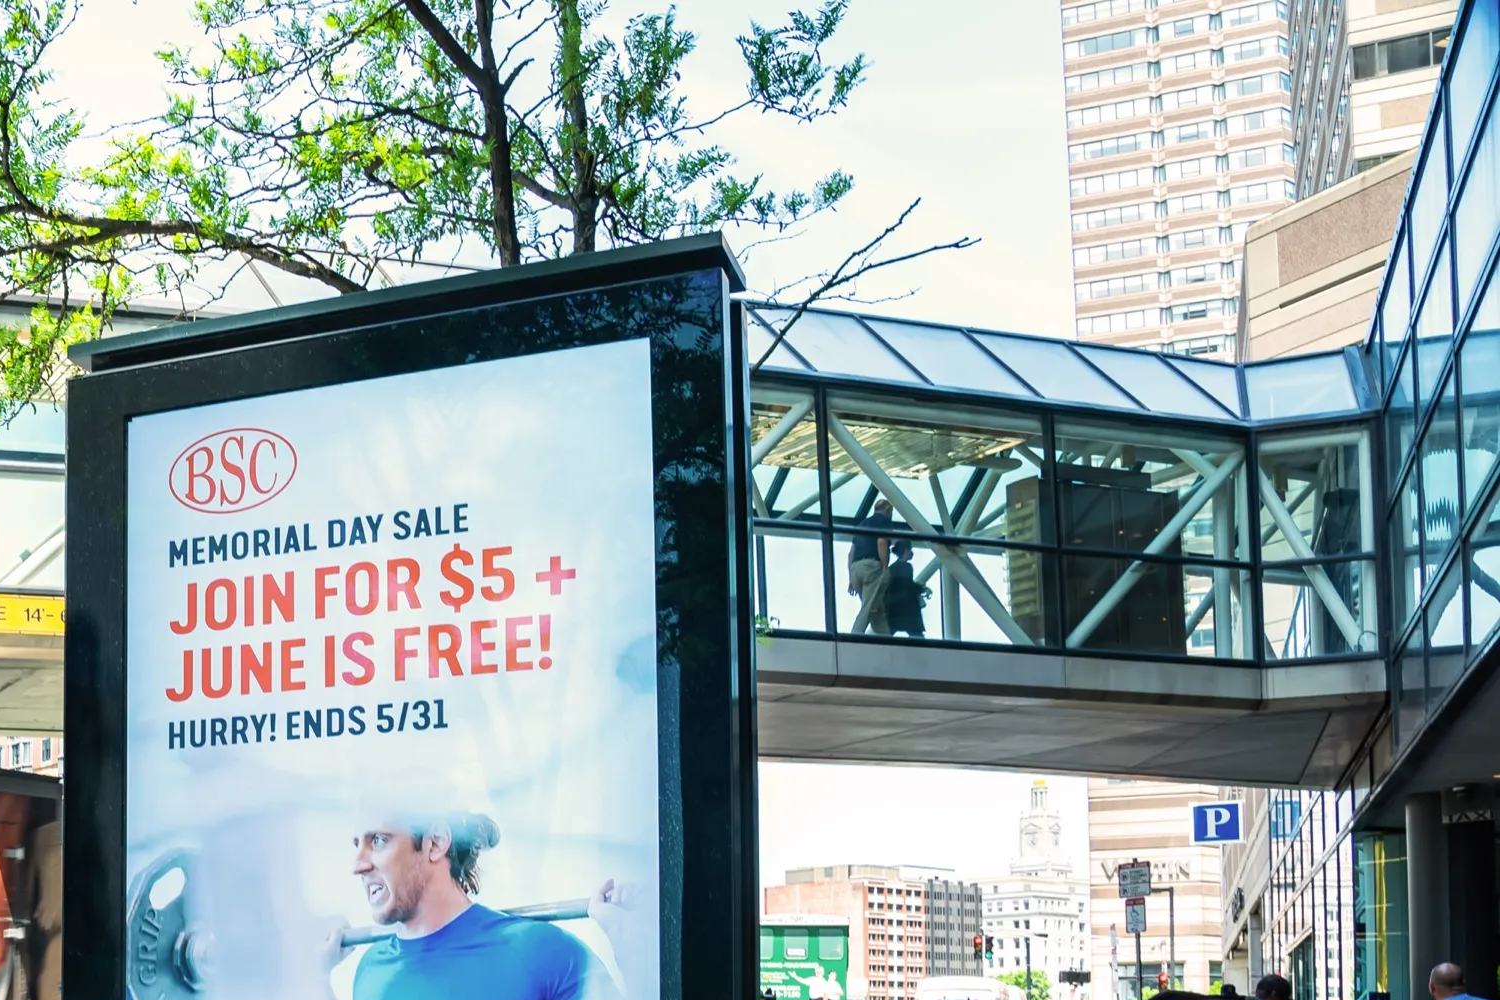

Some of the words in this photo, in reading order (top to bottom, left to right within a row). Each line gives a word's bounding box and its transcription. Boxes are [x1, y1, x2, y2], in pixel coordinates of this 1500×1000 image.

[185, 436, 278, 507] BSC
[169, 523, 317, 568] MEMORIAL
[328, 514, 384, 548] DAY
[393, 503, 469, 540] SALE
[169, 571, 295, 635] JOIN
[314, 557, 423, 620] FOR
[439, 542, 516, 613] $5
[165, 637, 307, 703] JUNE
[324, 631, 375, 688] IS
[393, 614, 553, 682] FREE!
[168, 712, 278, 750] HURRY!
[286, 705, 366, 741] ENDS
[375, 699, 449, 733] 5/31
[1203, 808, 1231, 838] P
[1101, 861, 1190, 882] WTIN
